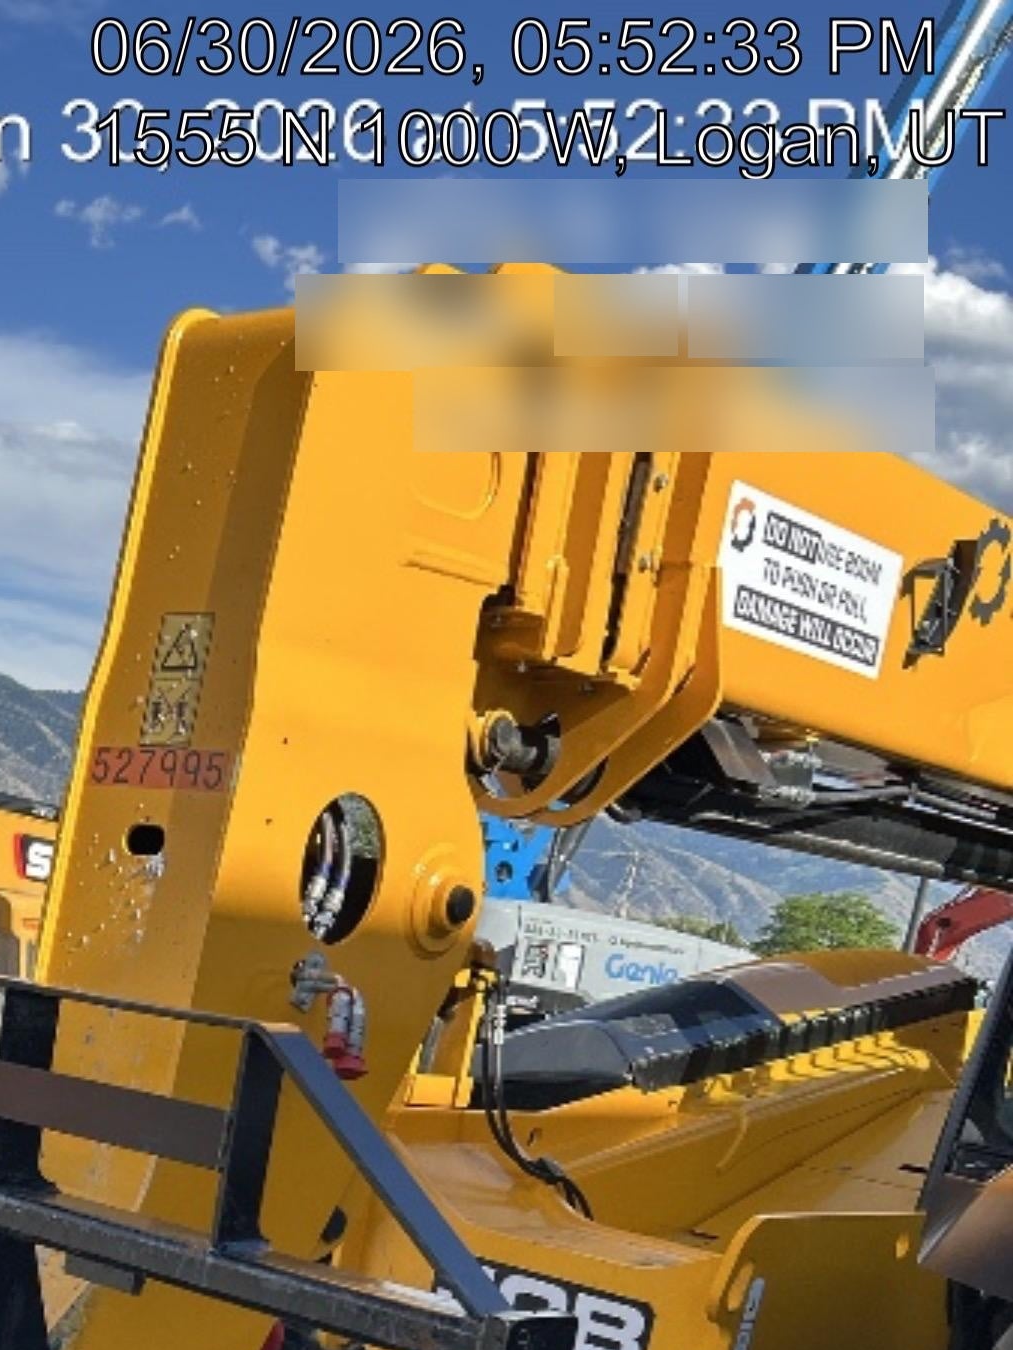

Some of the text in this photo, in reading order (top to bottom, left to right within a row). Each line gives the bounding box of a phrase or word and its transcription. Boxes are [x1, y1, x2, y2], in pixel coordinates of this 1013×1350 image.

[765, 516, 789, 546] DO
[788, 526, 819, 560] NOT
[91, 746, 225, 790] 527995
